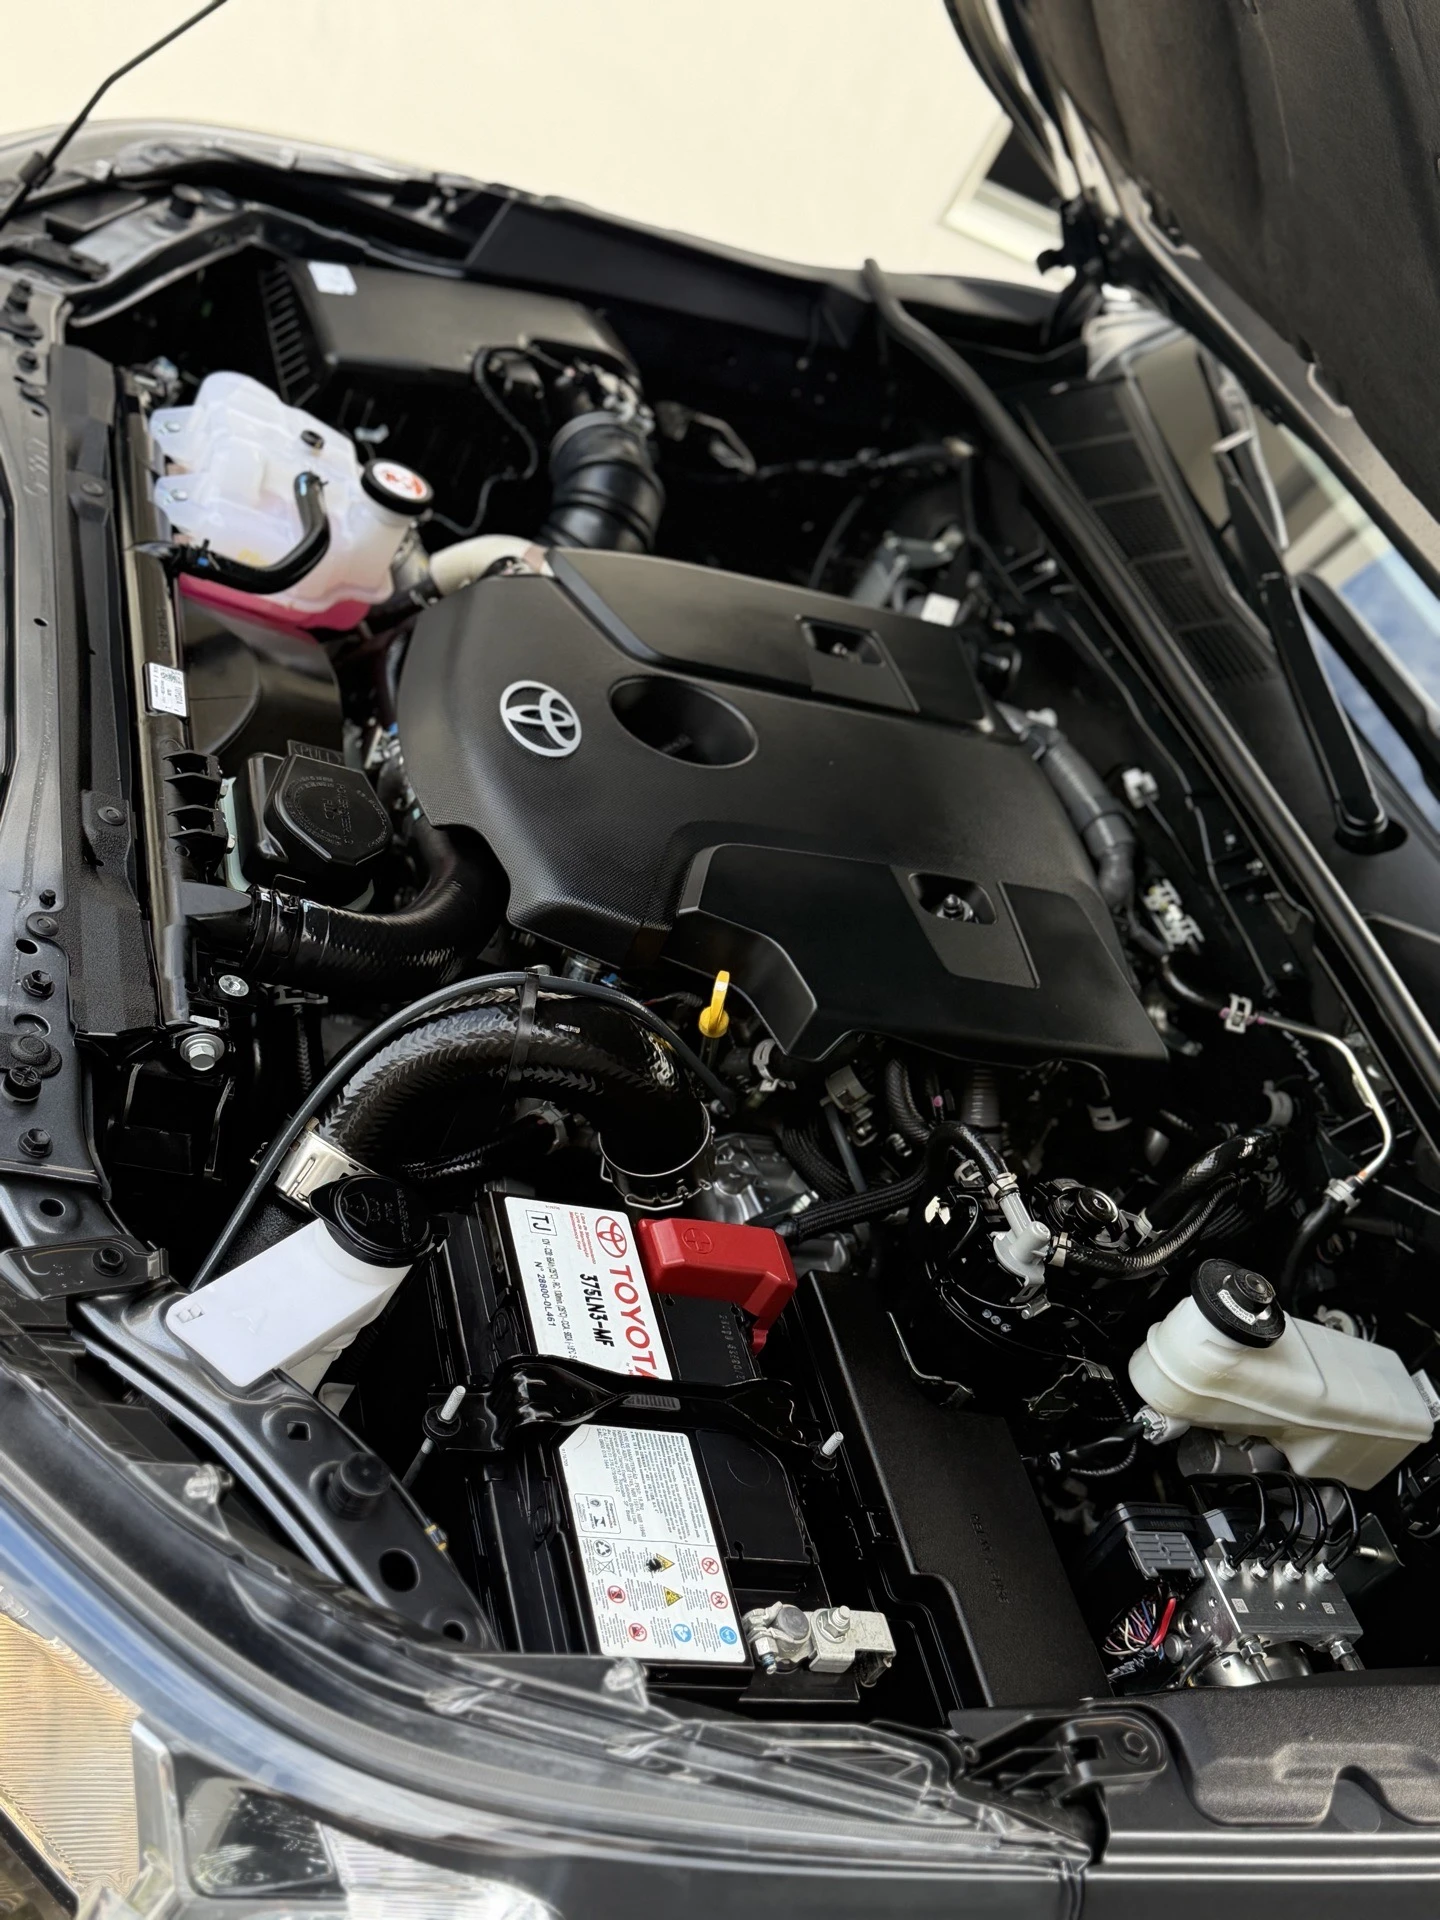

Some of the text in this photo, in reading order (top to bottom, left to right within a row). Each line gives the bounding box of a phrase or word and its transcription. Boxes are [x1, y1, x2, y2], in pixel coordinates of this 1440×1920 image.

[530, 1214, 551, 1231] TJ
[537, 1273, 556, 1327] 28800-0L461
[578, 1273, 615, 1347] 375LN3-MF
